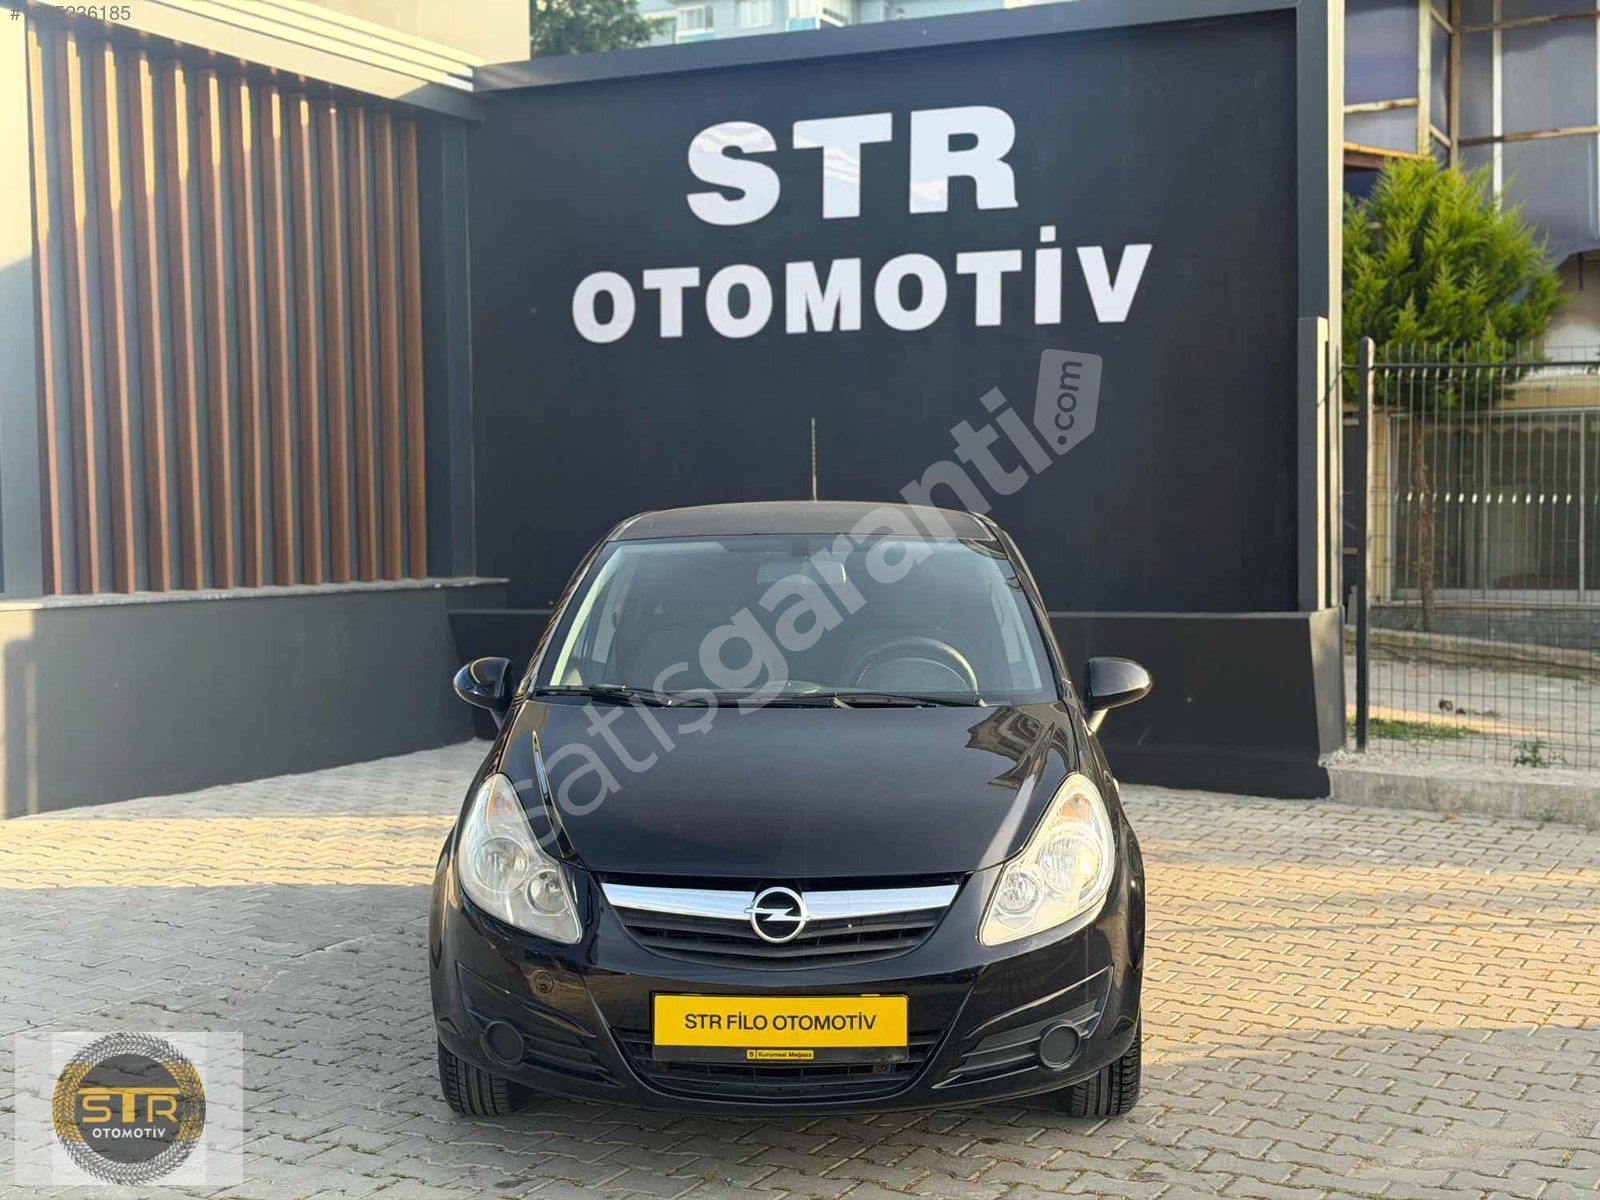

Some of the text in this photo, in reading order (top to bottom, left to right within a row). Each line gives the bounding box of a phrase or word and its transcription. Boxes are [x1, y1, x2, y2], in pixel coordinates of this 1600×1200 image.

[687, 105, 1019, 226] STR
[572, 225, 1152, 344] OTOMOTİV
[684, 1011, 877, 1031] STR FİLO OTOMOTİV
